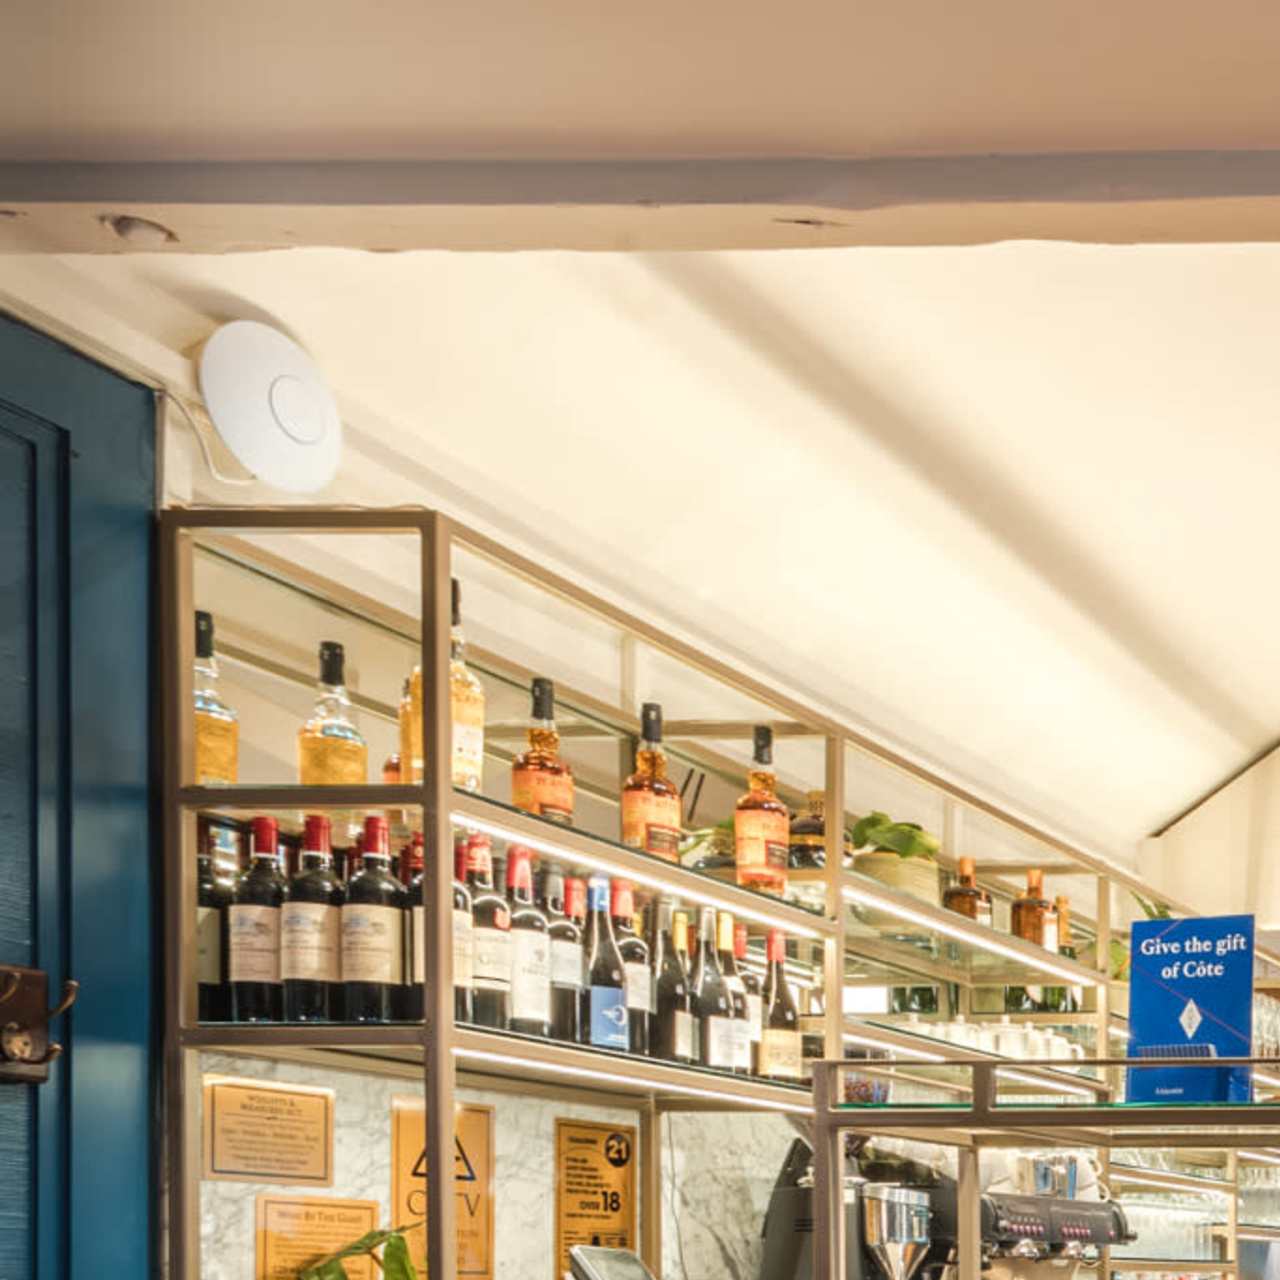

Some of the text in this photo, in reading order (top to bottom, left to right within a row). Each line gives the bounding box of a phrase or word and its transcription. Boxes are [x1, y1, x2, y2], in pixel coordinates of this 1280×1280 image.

[1140, 933, 1248, 957] Give the gift
[1161, 960, 1226, 979] of Côte
[608, 1140, 628, 1160] 21
[601, 1191, 621, 1213] 18
